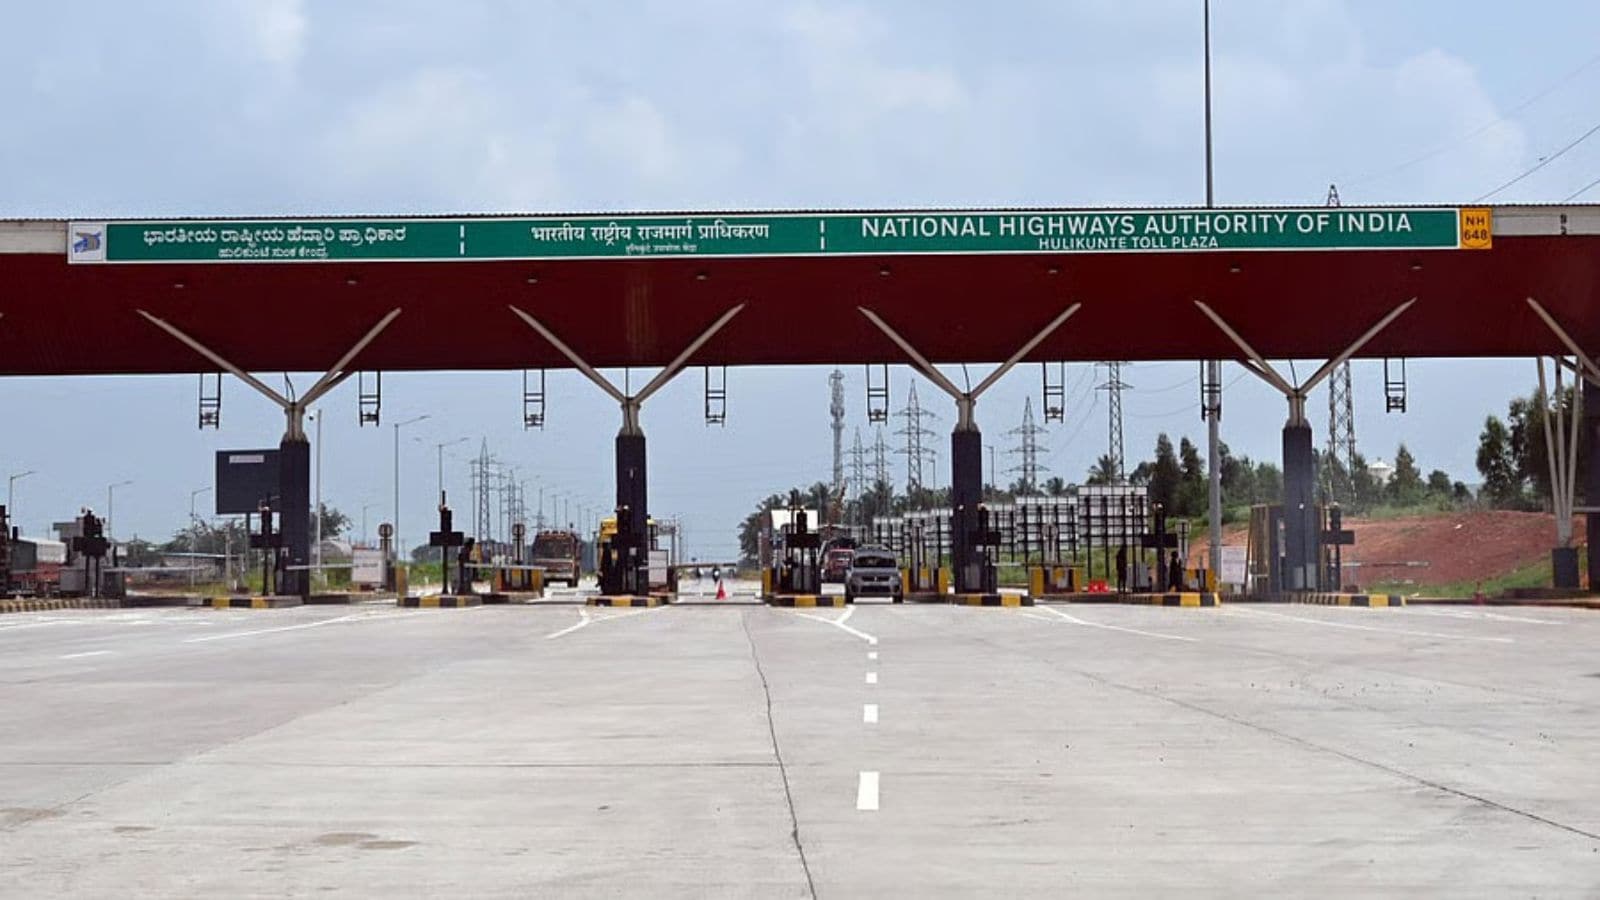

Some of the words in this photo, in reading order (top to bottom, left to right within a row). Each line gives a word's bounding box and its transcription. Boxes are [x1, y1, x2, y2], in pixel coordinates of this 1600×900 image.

[861, 217, 990, 236] NATIONAL
[999, 215, 1135, 235] HIGHWAYS
[1144, 214, 1288, 234] AUTHORITY
[1296, 213, 1330, 232] OF
[1339, 212, 1412, 231] INDIA
[1466, 215, 1485, 225] NH
[531, 222, 586, 241] भारतीय
[589, 221, 632, 245] राष्ट्रीय
[636, 219, 693, 240] राजमार्ग
[697, 218, 770, 239] प्राधिकरण
[1464, 229, 1488, 241] 648
[1039, 237, 1127, 251] HULIKUNTE
[1131, 237, 1167, 250] TOLL
[1171, 236, 1219, 250] PLAZA
